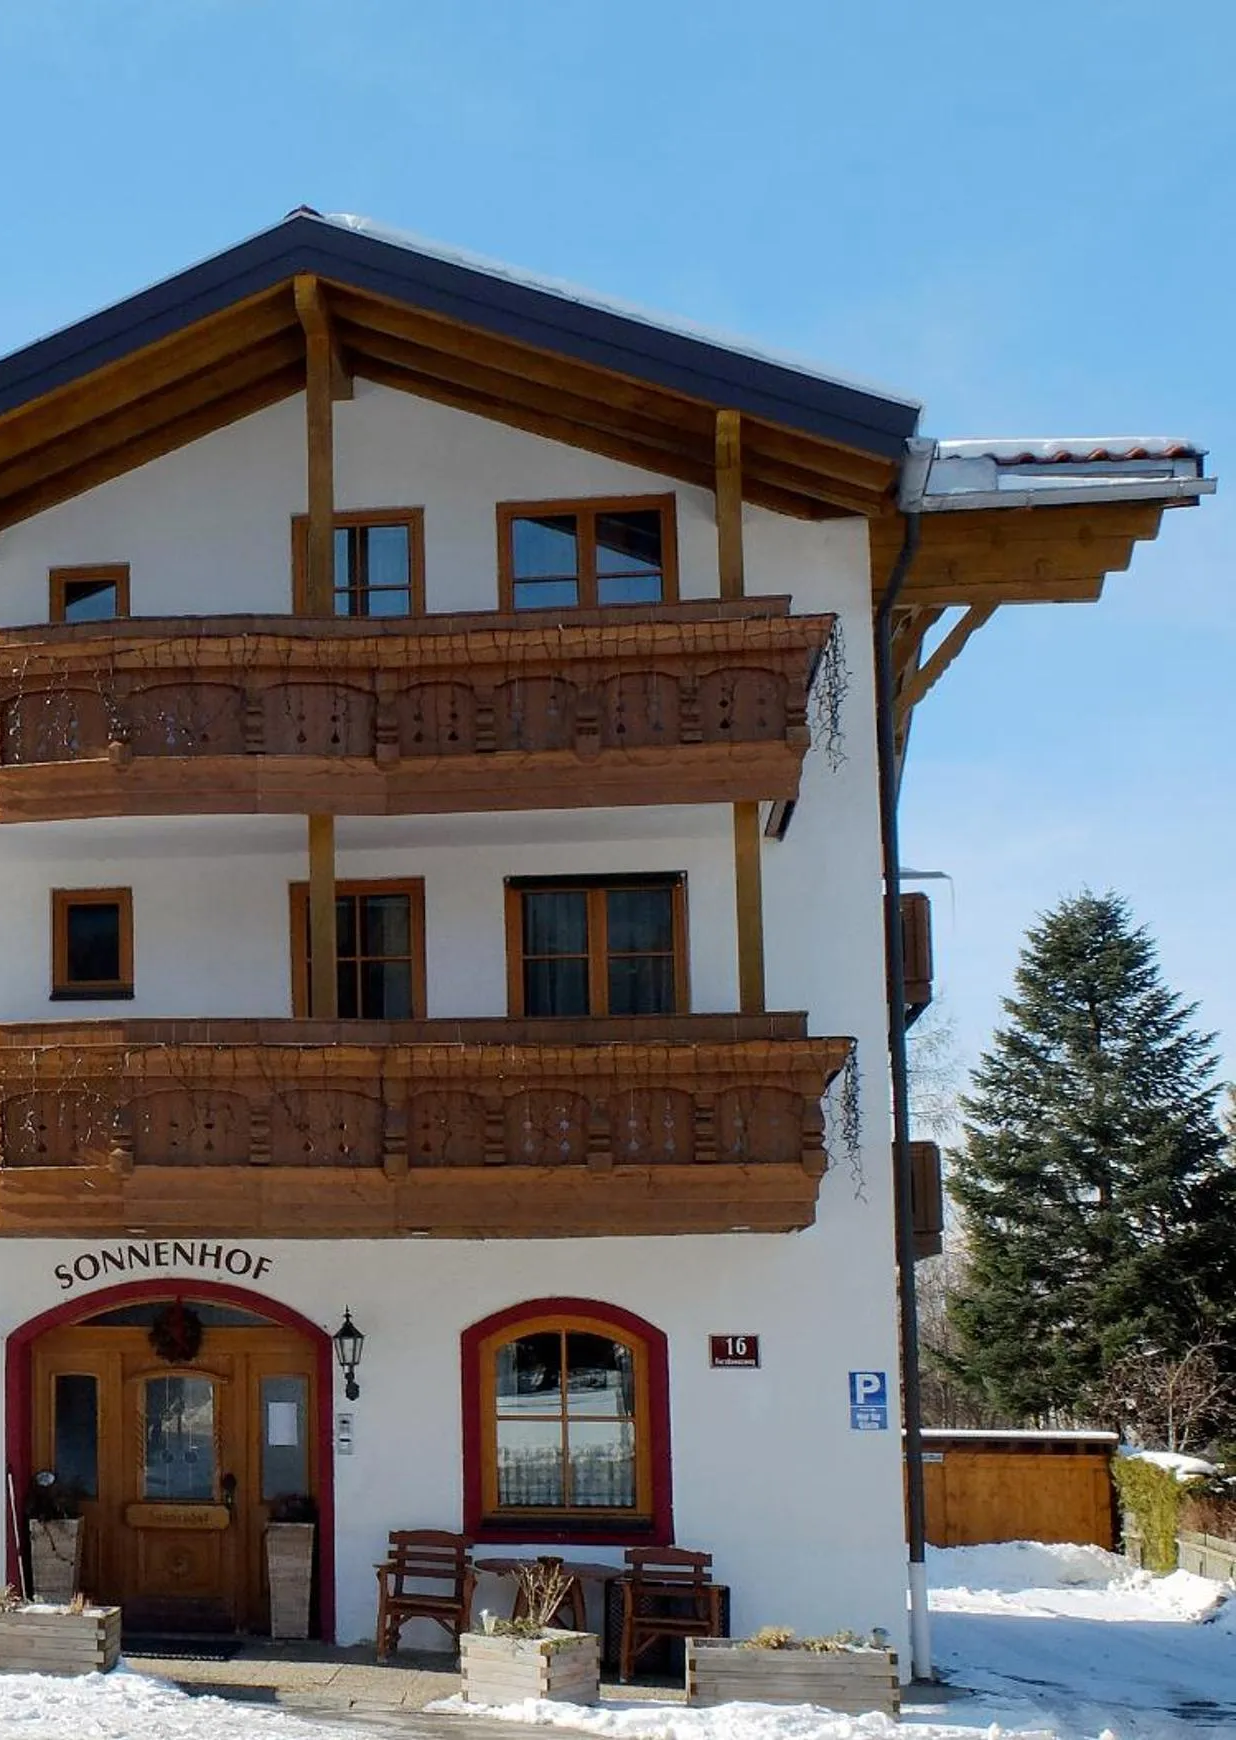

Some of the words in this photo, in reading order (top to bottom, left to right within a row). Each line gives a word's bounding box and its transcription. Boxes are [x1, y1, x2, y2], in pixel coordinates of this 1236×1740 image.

[54, 1241, 273, 1290] SONNENHOF
[725, 1337, 747, 1355] 16
[855, 1373, 881, 1404] P
